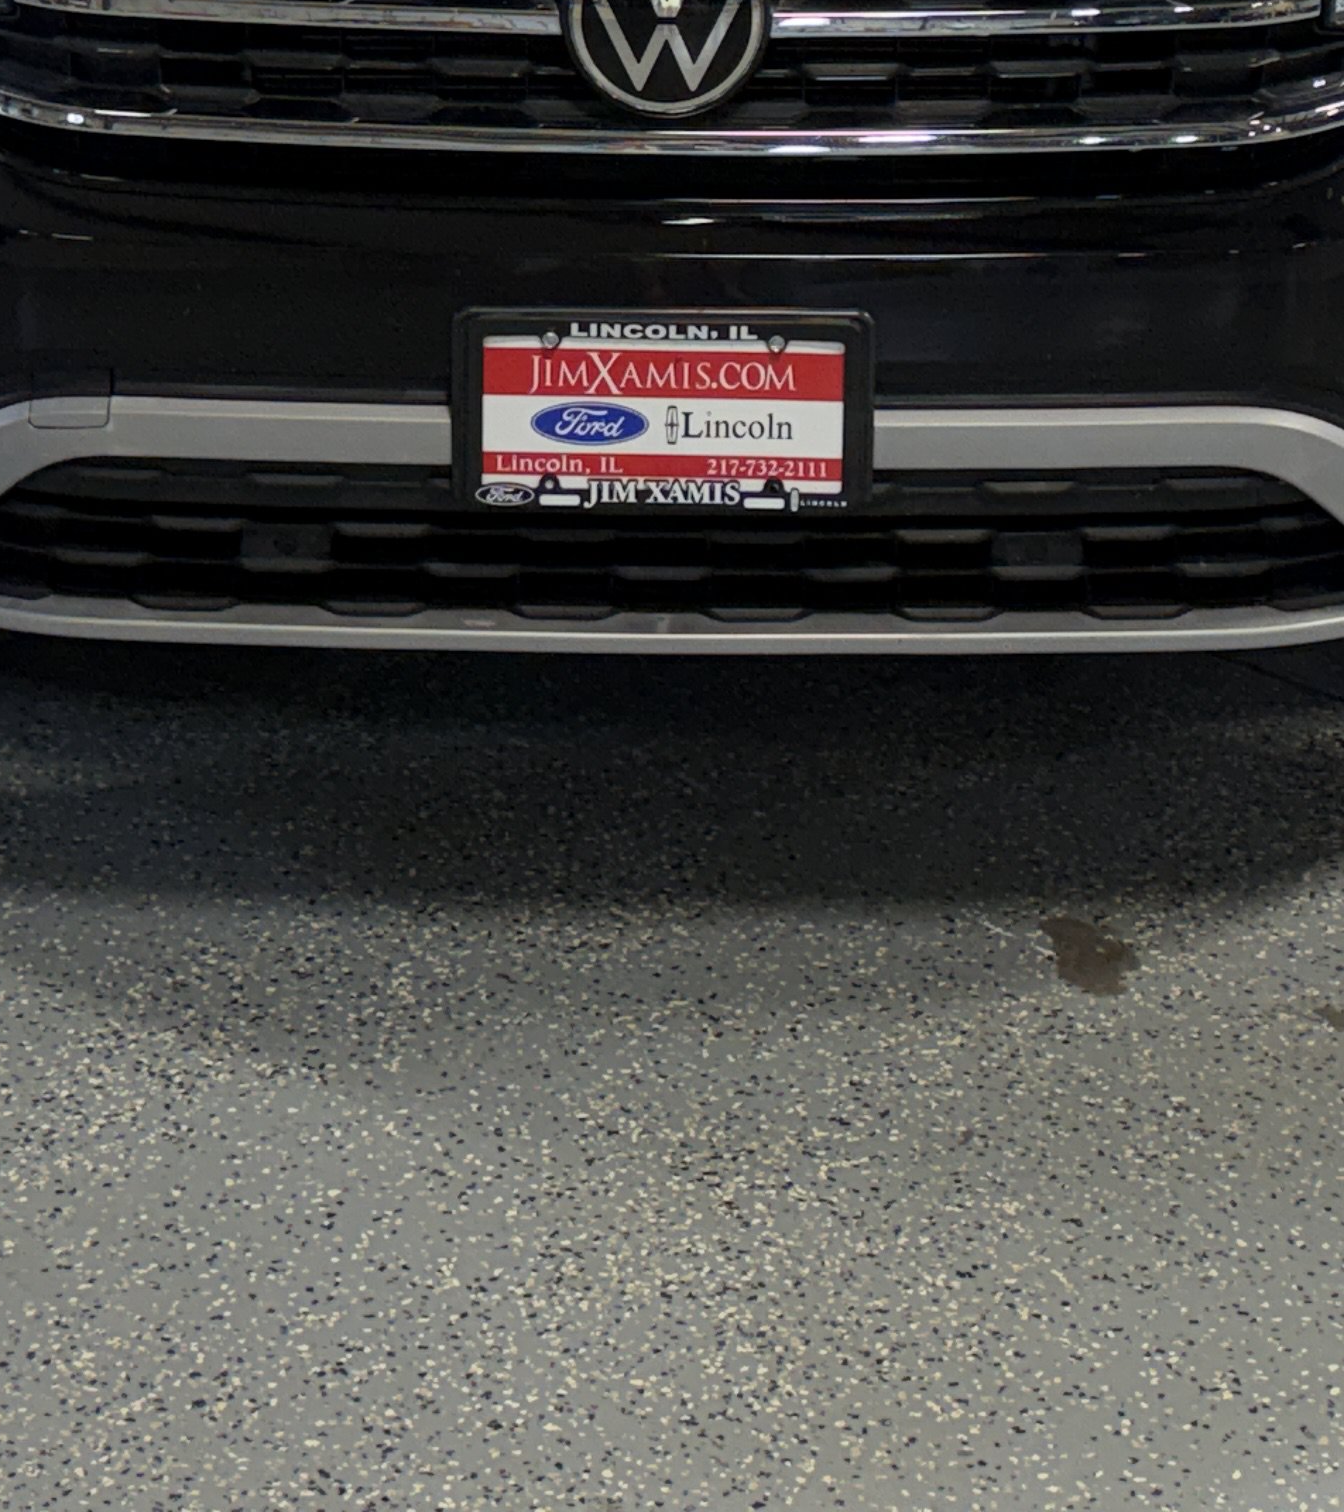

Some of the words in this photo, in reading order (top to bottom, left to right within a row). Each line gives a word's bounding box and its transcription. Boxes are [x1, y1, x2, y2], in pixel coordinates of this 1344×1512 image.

[570, 322, 719, 339] LINCOLN,
[728, 324, 758, 340] IL
[554, 407, 625, 437] Ford
[681, 411, 793, 440] Lincoln
[496, 454, 591, 474] Lincoln,
[600, 457, 623, 473] IL
[707, 458, 827, 477] 217-732-2111
[583, 480, 638, 509] JIM
[644, 481, 741, 506] XAMIS
